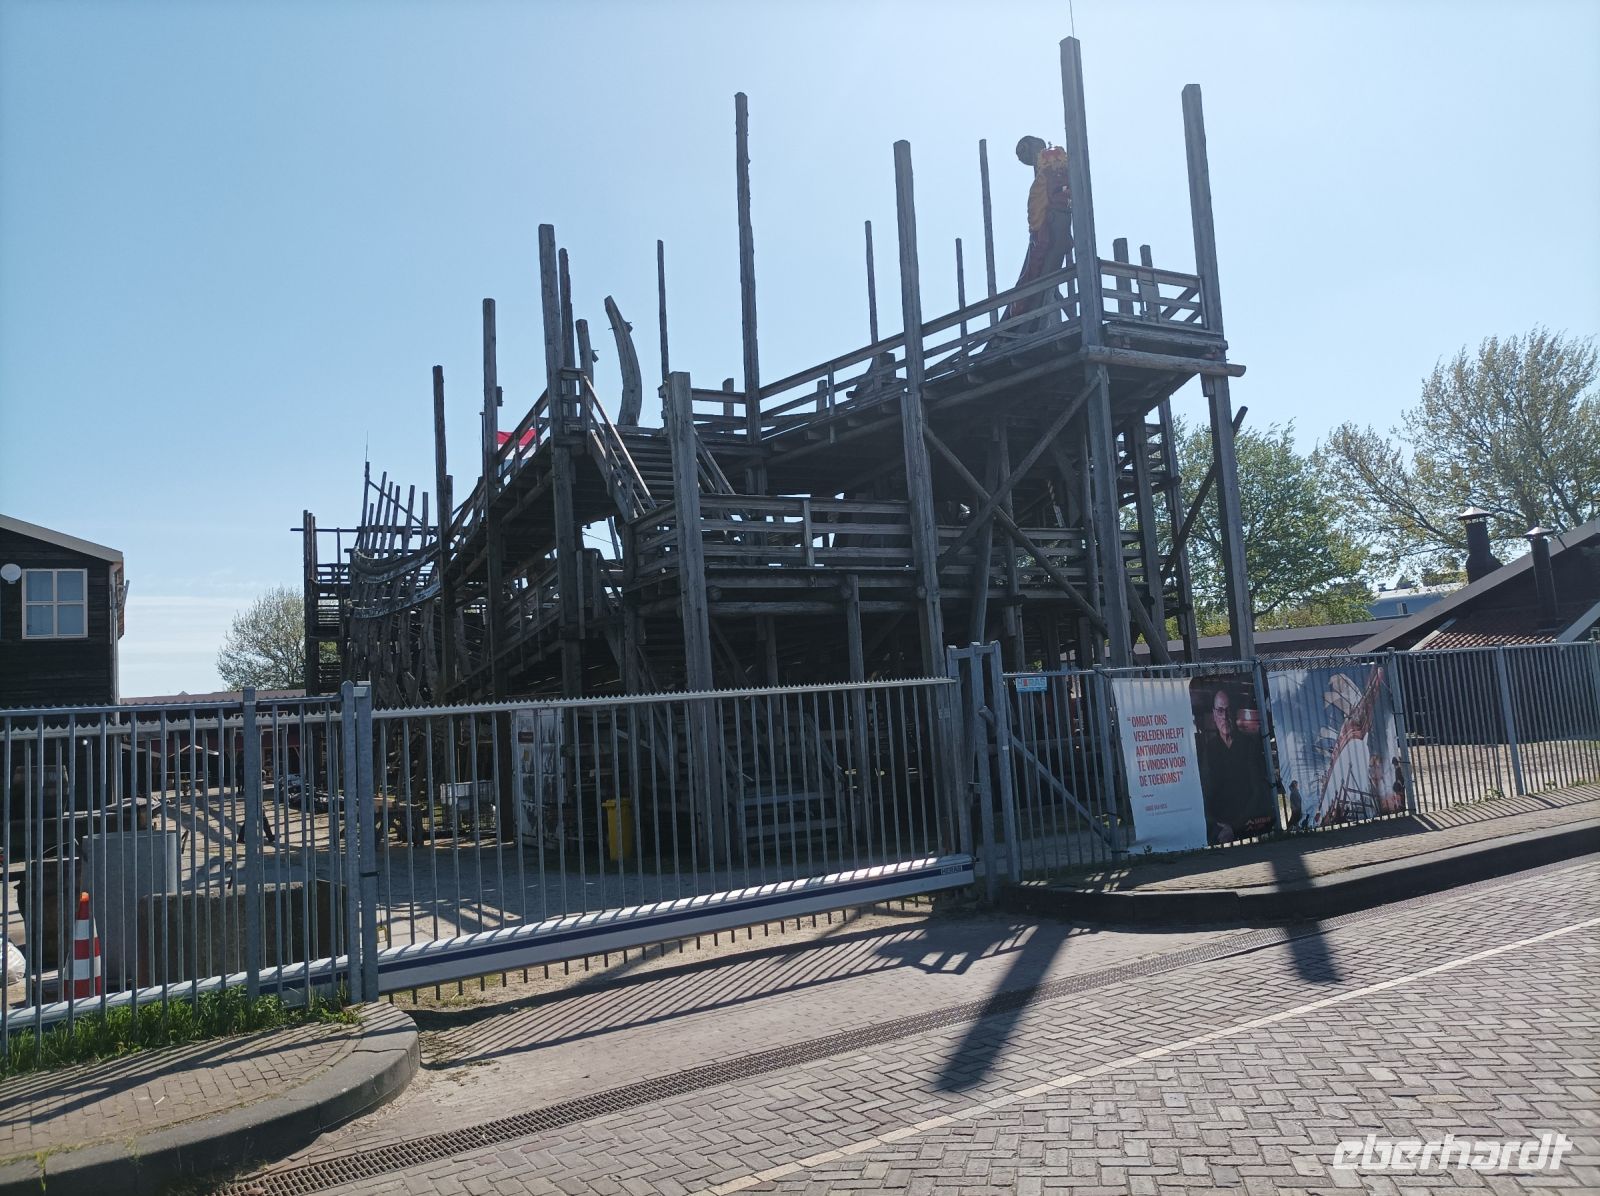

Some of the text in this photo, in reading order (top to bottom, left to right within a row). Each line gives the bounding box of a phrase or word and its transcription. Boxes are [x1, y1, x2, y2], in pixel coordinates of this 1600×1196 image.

[1154, 714, 1168, 725] ONS
[1133, 727, 1185, 742] VERLEDEN HELPT
[1136, 743, 1178, 757] ANTWOORDEN
[1137, 756, 1186, 772] TE VINDEN VOOR
[1139, 775, 1148, 787] DE
